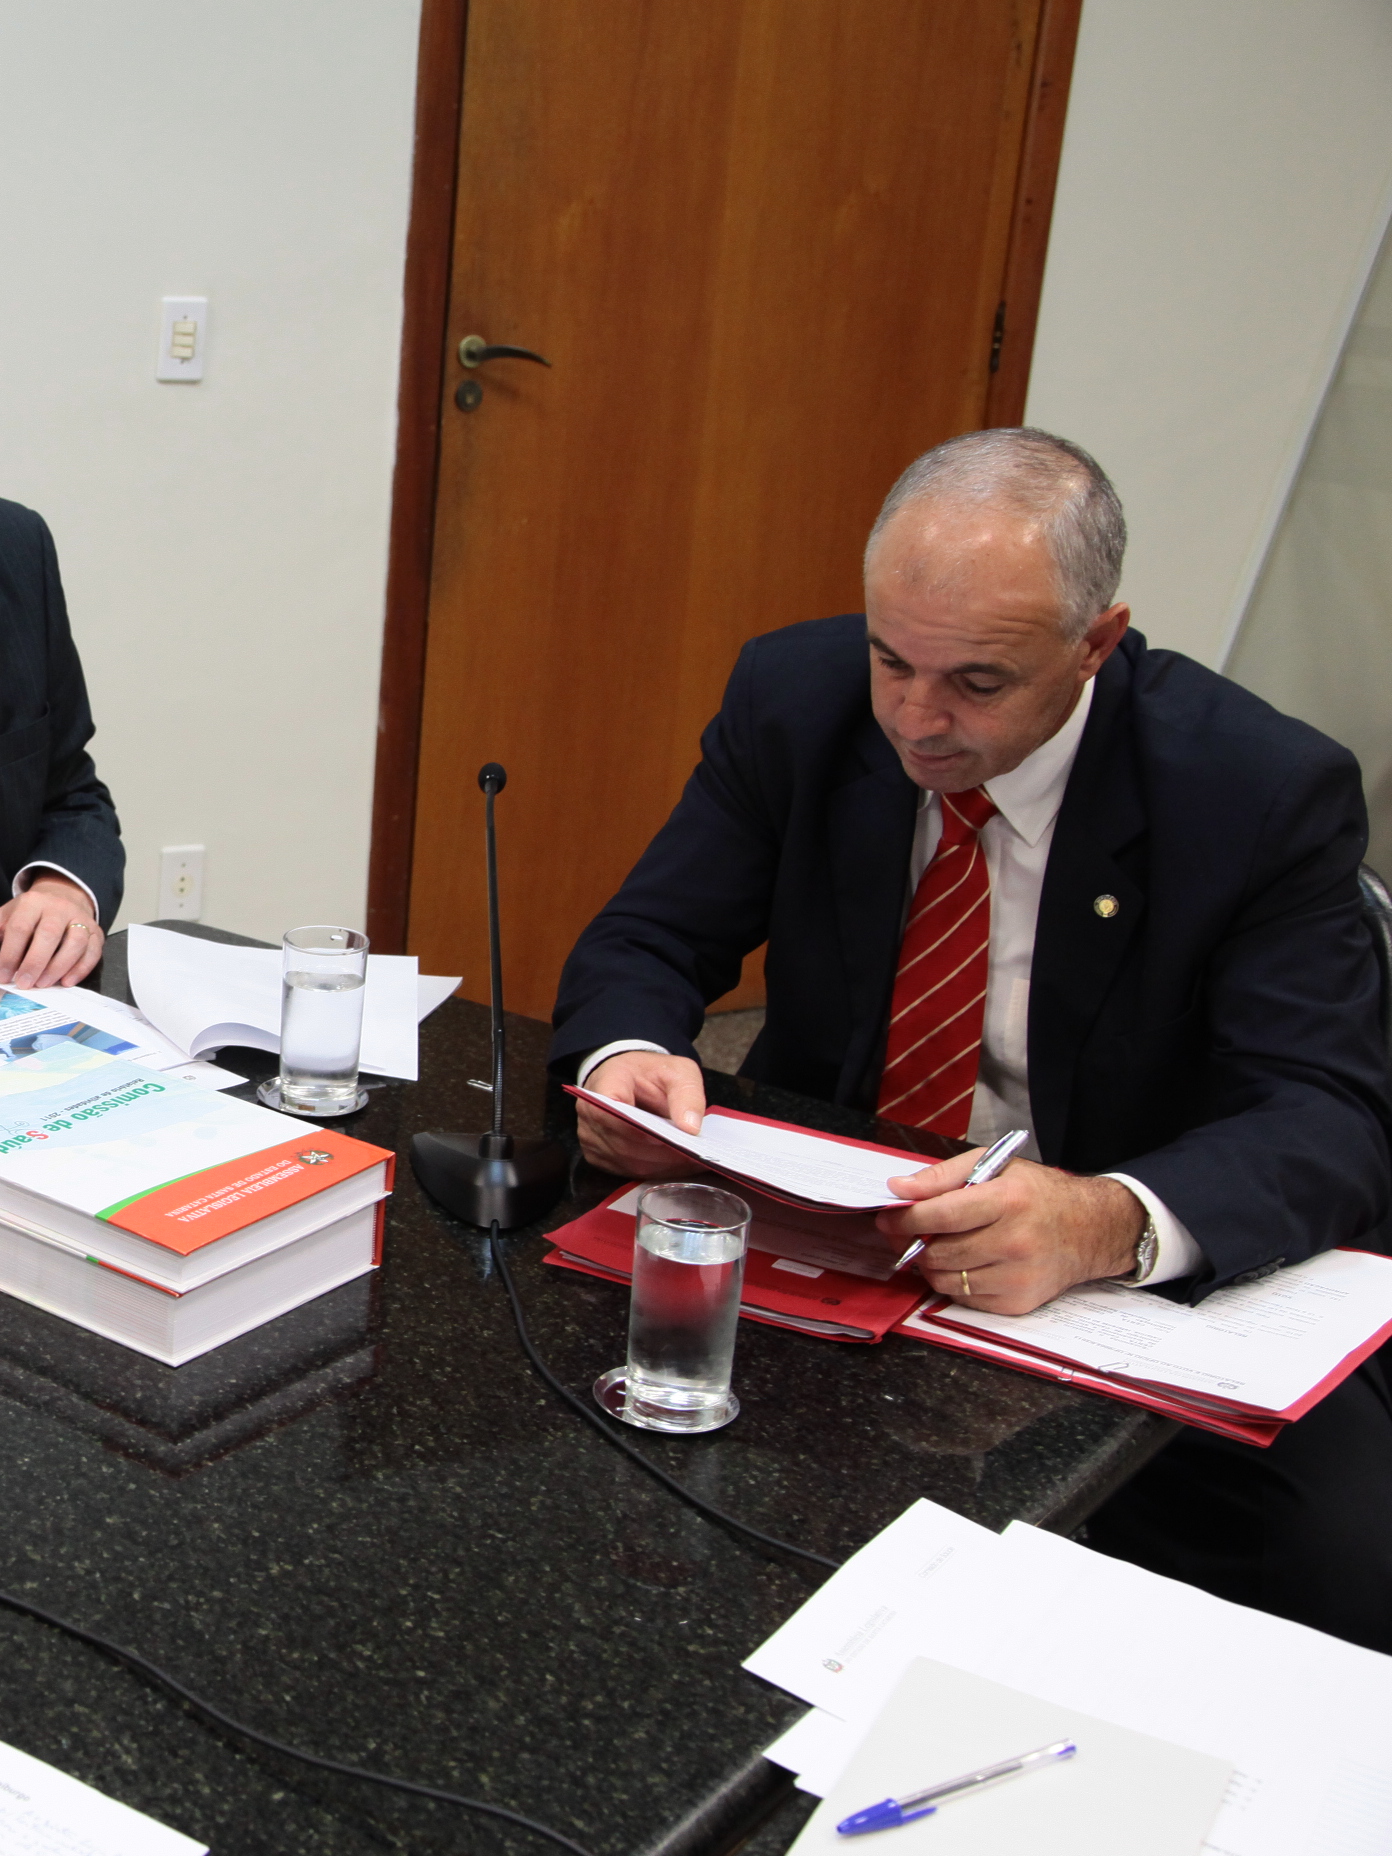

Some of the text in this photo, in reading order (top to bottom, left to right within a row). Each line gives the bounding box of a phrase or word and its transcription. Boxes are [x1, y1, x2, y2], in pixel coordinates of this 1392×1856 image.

[64, 1095, 101, 1112] atividades
[71, 1083, 166, 1121] Comissão
[40, 1112, 60, 1122] 2011
[43, 1119, 73, 1132] de
[164, 1159, 292, 1217] DO ESTADO DE SANTA CATARINA
[177, 1163, 305, 1223] ASSEMBLEIA LEGISLATIVA
